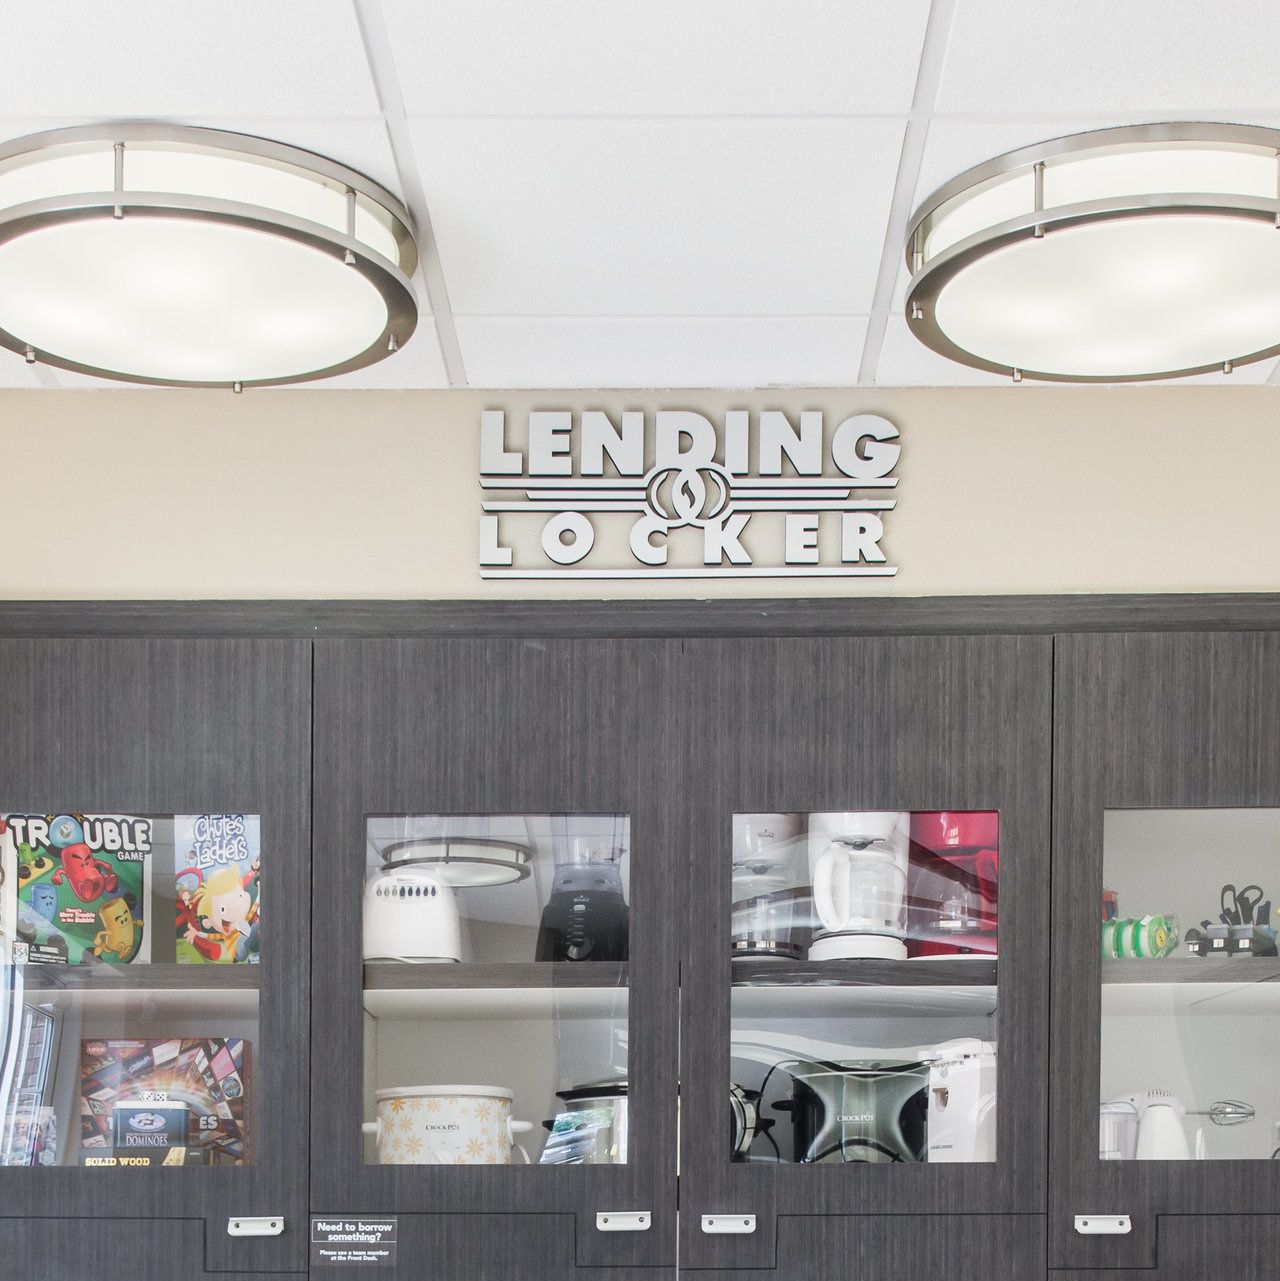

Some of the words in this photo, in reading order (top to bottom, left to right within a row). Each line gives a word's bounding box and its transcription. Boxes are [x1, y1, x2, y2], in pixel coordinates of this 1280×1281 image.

[480, 410, 901, 478] LENDING
[479, 512, 887, 565] LOCKER
[9, 815, 151, 852] TROUBLE
[194, 815, 244, 841] Chutes
[117, 851, 144, 861] GAME
[194, 837, 248, 868] Ladders
[126, 1135, 168, 1147] DOMINOES
[85, 1157, 116, 1167] SOLID
[119, 1157, 151, 1167] WOOD
[317, 1222, 343, 1231] Need
[345, 1223, 356, 1231] to
[358, 1222, 393, 1231] borrow
[328, 1232, 382, 1243] something?
